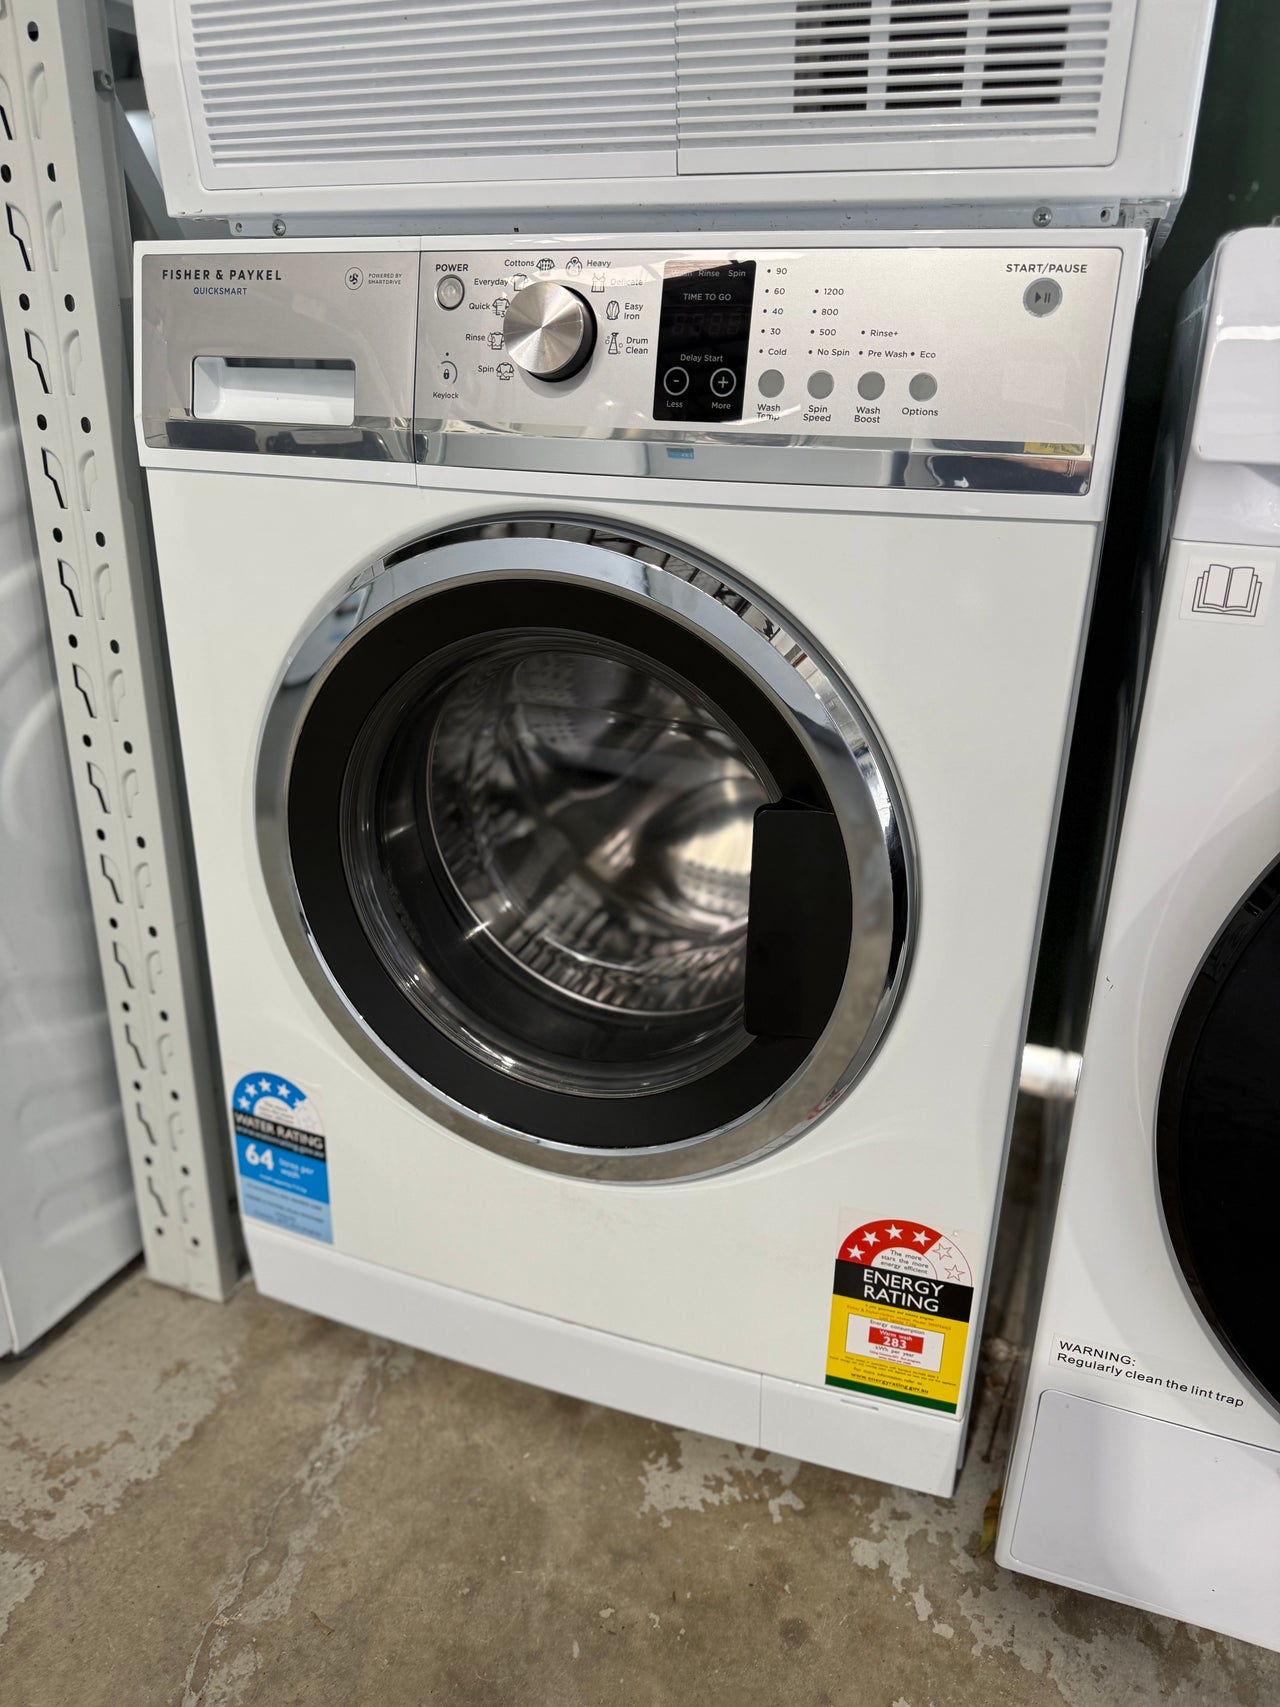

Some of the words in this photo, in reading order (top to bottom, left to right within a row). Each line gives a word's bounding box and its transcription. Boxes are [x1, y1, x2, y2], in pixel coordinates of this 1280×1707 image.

[436, 264, 468, 272] POWER
[587, 260, 611, 268] Heavy
[1006, 263, 1088, 274] START/PAUSE
[162, 269, 210, 280] FISHER
[216, 270, 223, 280] &
[230, 270, 281, 280] PAYKEL
[728, 270, 746, 278] Spin
[474, 278, 508, 287] Everyday
[193, 287, 247, 295] QUICKSMART
[824, 288, 844, 296] 1200
[625, 303, 643, 311] Easy
[821, 308, 839, 316] 800
[870, 329, 898, 337] Rinse+
[768, 348, 787, 356] Cold
[830, 349, 850, 358] Spin
[868, 350, 882, 358] Pre
[884, 350, 908, 358] Wash
[920, 351, 936, 359] Eco
[680, 354, 702, 362] Delay
[704, 354, 723, 362] Start
[433, 392, 458, 400] Keylock
[757, 404, 781, 412] Wash
[808, 405, 828, 414] Spin
[856, 406, 880, 415] Wash
[902, 408, 938, 417] Options
[803, 414, 831, 423] Speed
[854, 415, 880, 424] Boost
[235, 1112, 275, 1135] WATER
[276, 1125, 323, 1149] RATING
[245, 1143, 274, 1170] 64
[881, 1261, 901, 1270] energy
[904, 1265, 928, 1274] efficient
[912, 1261, 928, 1269] more
[863, 1269, 944, 1297] ENERGY
[864, 1285, 939, 1312] RATING
[870, 1320, 888, 1328] Energy
[890, 1324, 925, 1335] consumption
[883, 1336, 907, 1349] 283
[1060, 1341, 1136, 1366] WARNING:
[1057, 1353, 1123, 1377] Regularly
[1125, 1370, 1162, 1386] clean
[1166, 1379, 1188, 1392] the
[1191, 1385, 1213, 1399] lint
[1216, 1393, 1244, 1408] trap
